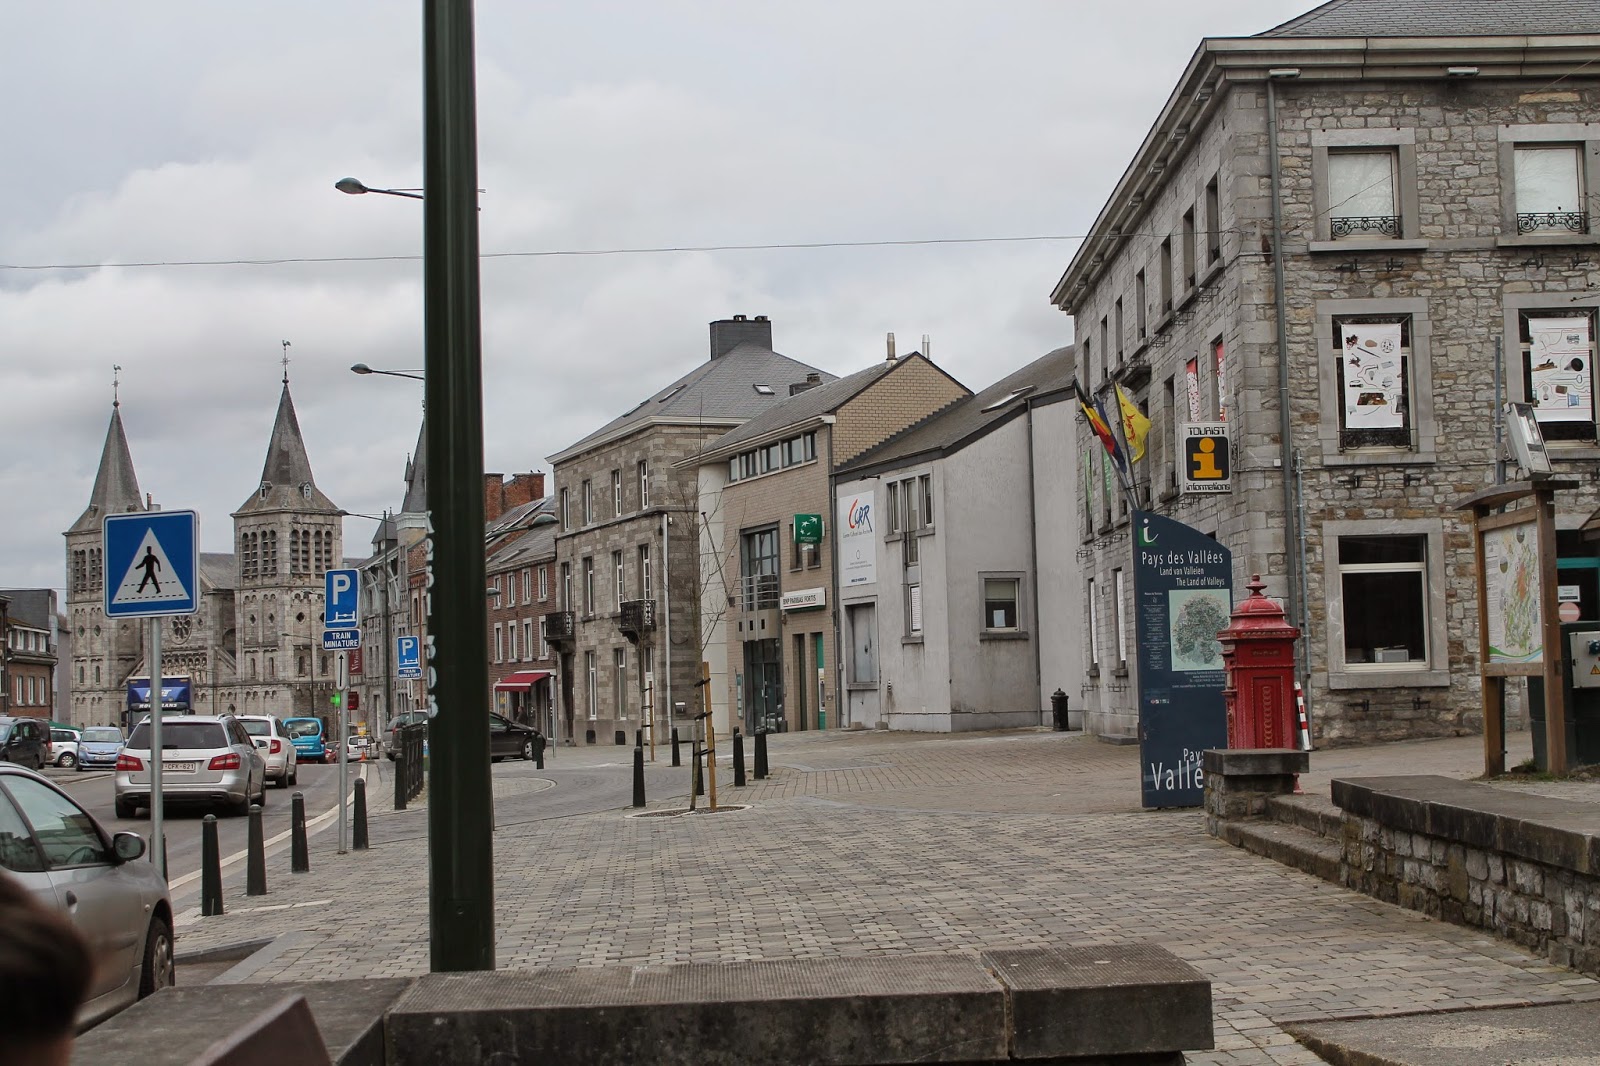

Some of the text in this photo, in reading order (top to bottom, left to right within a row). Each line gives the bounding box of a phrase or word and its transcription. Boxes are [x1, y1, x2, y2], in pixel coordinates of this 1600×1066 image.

[1188, 427, 1226, 436] TOURIST
[1186, 482, 1231, 491] informations
[1142, 550, 1223, 568] Pays des Vallées
[1160, 567, 1173, 576] Land
[1176, 576, 1225, 588] The Land of Valleys
[332, 574, 351, 605] P
[332, 632, 351, 640] TRAIN
[325, 639, 358, 648] MINIATURE
[402, 639, 414, 656] P
[1151, 760, 1204, 791] Vallé
